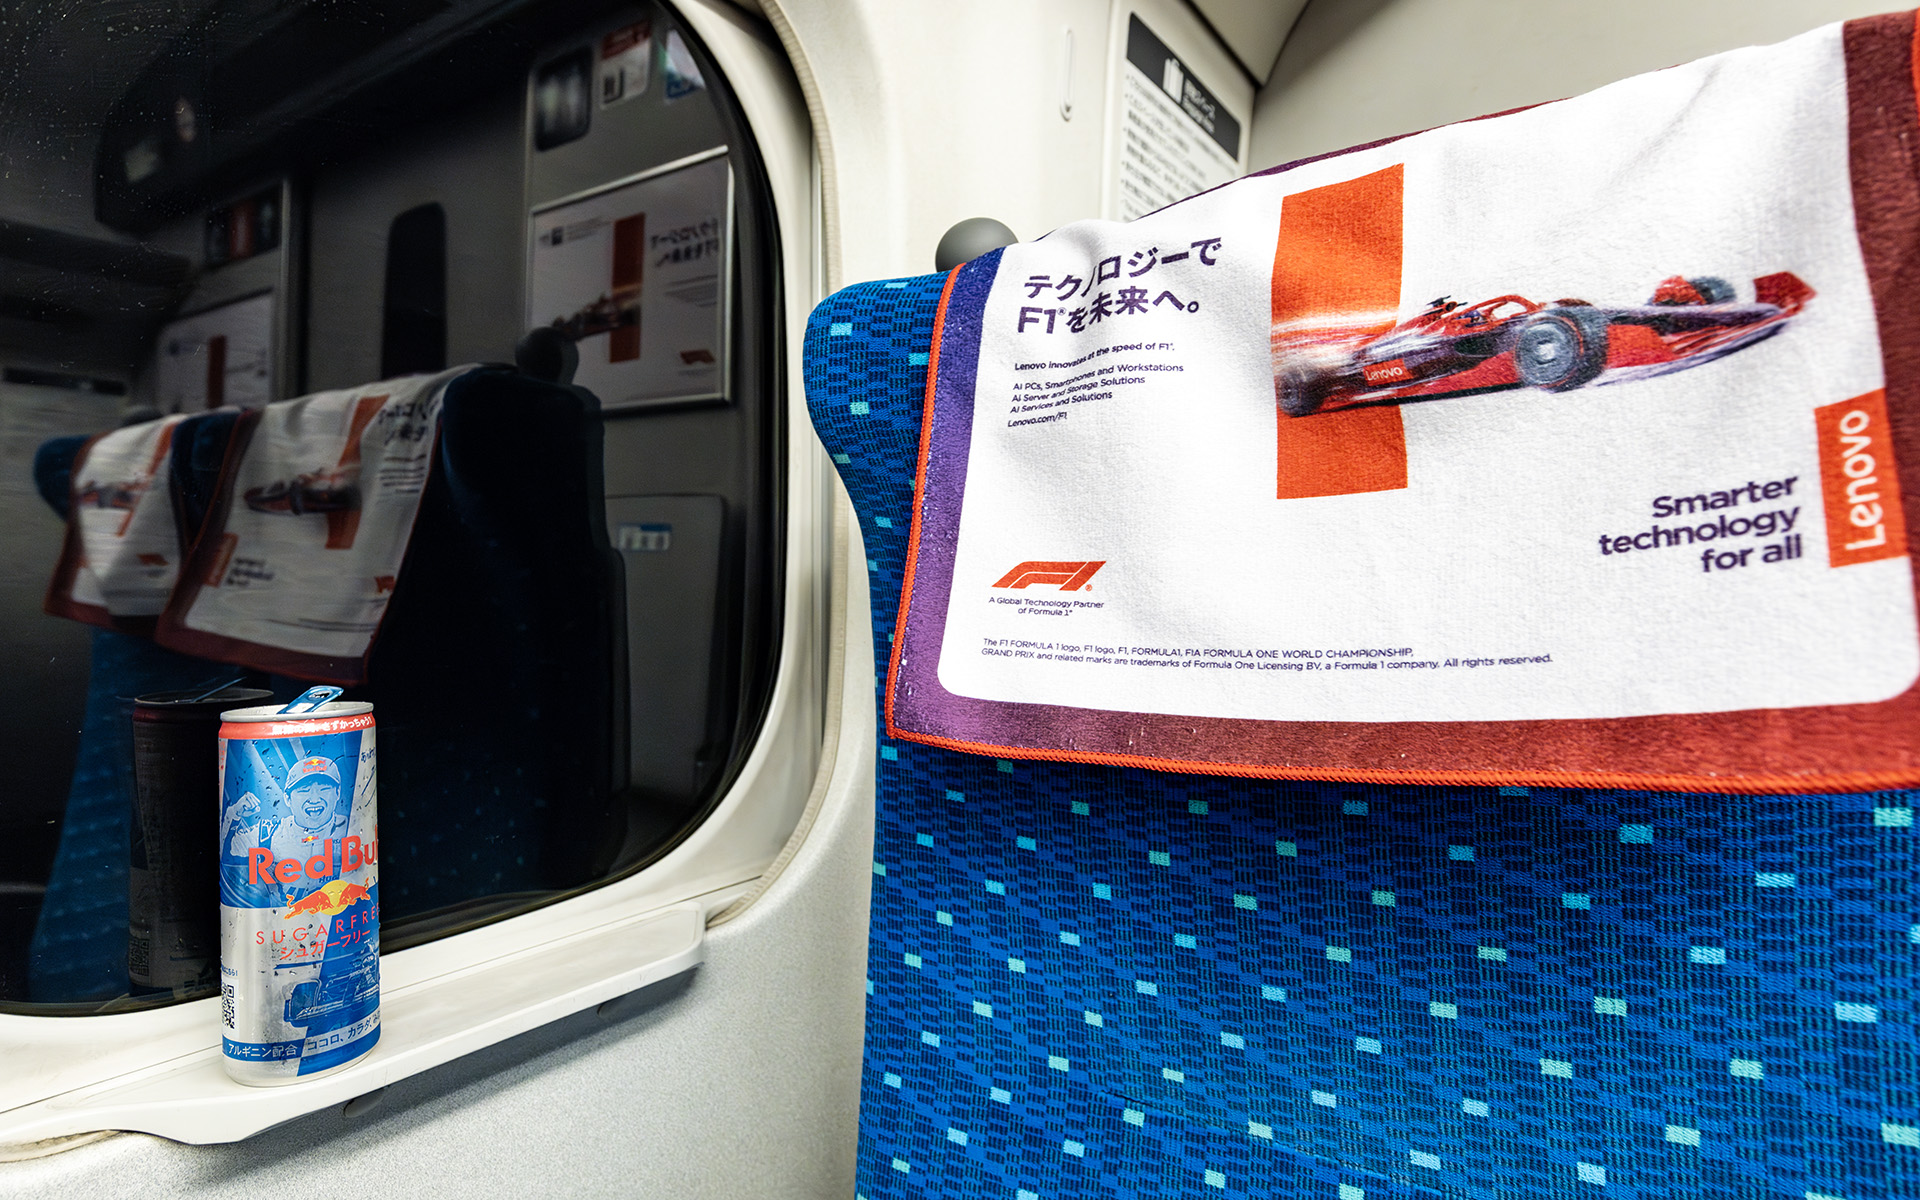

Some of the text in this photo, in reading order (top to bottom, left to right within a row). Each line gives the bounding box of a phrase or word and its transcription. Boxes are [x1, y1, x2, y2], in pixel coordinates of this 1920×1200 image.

[1024, 237, 1222, 301] テクノロジーで
[1014, 362, 1046, 371] Lenovo
[1049, 356, 1087, 369] innovates
[1087, 351, 1095, 361] at
[1096, 347, 1109, 357] the
[1111, 343, 1142, 353] speed
[1145, 342, 1156, 351] of
[1025, 383, 1043, 391] PCs,
[1045, 370, 1095, 390] Smartphones
[1097, 365, 1114, 376] and
[1117, 363, 1184, 372] Workstations
[1365, 367, 1403, 381] Lenovo
[1021, 401, 1053, 413] Services
[1054, 397, 1069, 407] and
[1071, 390, 1113, 403] Solutions
[1023, 393, 1049, 402] Server
[1051, 389, 1066, 398] and
[1067, 380, 1098, 394] Storage
[1100, 375, 1146, 387] Solutions
[1007, 411, 1067, 427] Lenovo.com/F1
[1839, 409, 1887, 550] Lenovo
[1652, 475, 1799, 518] Smarter
[1599, 506, 1801, 556] technology
[1701, 533, 1802, 573] for all
[997, 597, 1022, 605] Global
[1024, 598, 1072, 609] Technology
[1073, 600, 1105, 609] Partner
[1028, 607, 1062, 616] Formula
[981, 648, 1013, 657] GRAND
[1014, 650, 1035, 658] PRIX
[1036, 651, 1053, 660] and
[1054, 652, 1084, 662] related
[1086, 655, 1112, 664] marks
[1114, 657, 1128, 665] are
[1130, 658, 1180, 668] trademarks
[1182, 659, 1192, 668] of
[1194, 660, 1232, 669] Formula
[1234, 661, 1255, 669] One
[1257, 660, 1303, 672] Licensing
[1306, 661, 1322, 671] BV,
[1334, 660, 1378, 670] Formula
[1380, 660, 1385, 669] 1
[1386, 661, 1440, 672] company.
[1444, 658, 1459, 667] All
[1461, 657, 1495, 669] rights
[1498, 653, 1553, 666] reserved.
[983, 638, 998, 646] The
[999, 639, 1009, 647] F1
[1010, 640, 1053, 650] FORMULA
[1060, 643, 1081, 653] logo,
[1084, 644, 1094, 652] F1
[1094, 645, 1116, 655] logo,
[1118, 646, 1129, 655] F1,
[1185, 648, 1202, 657] FIA
[1203, 649, 1253, 658] FORMULA
[1255, 650, 1279, 659] ONE
[1282, 650, 1323, 659] WORLD
[1325, 648, 1414, 658] CHAMPIONSHIP,
[248, 825, 378, 885] Red Bul
[280, 929, 371, 960] シュガーフリー
[228, 1043, 298, 1058] アルギニン配合
